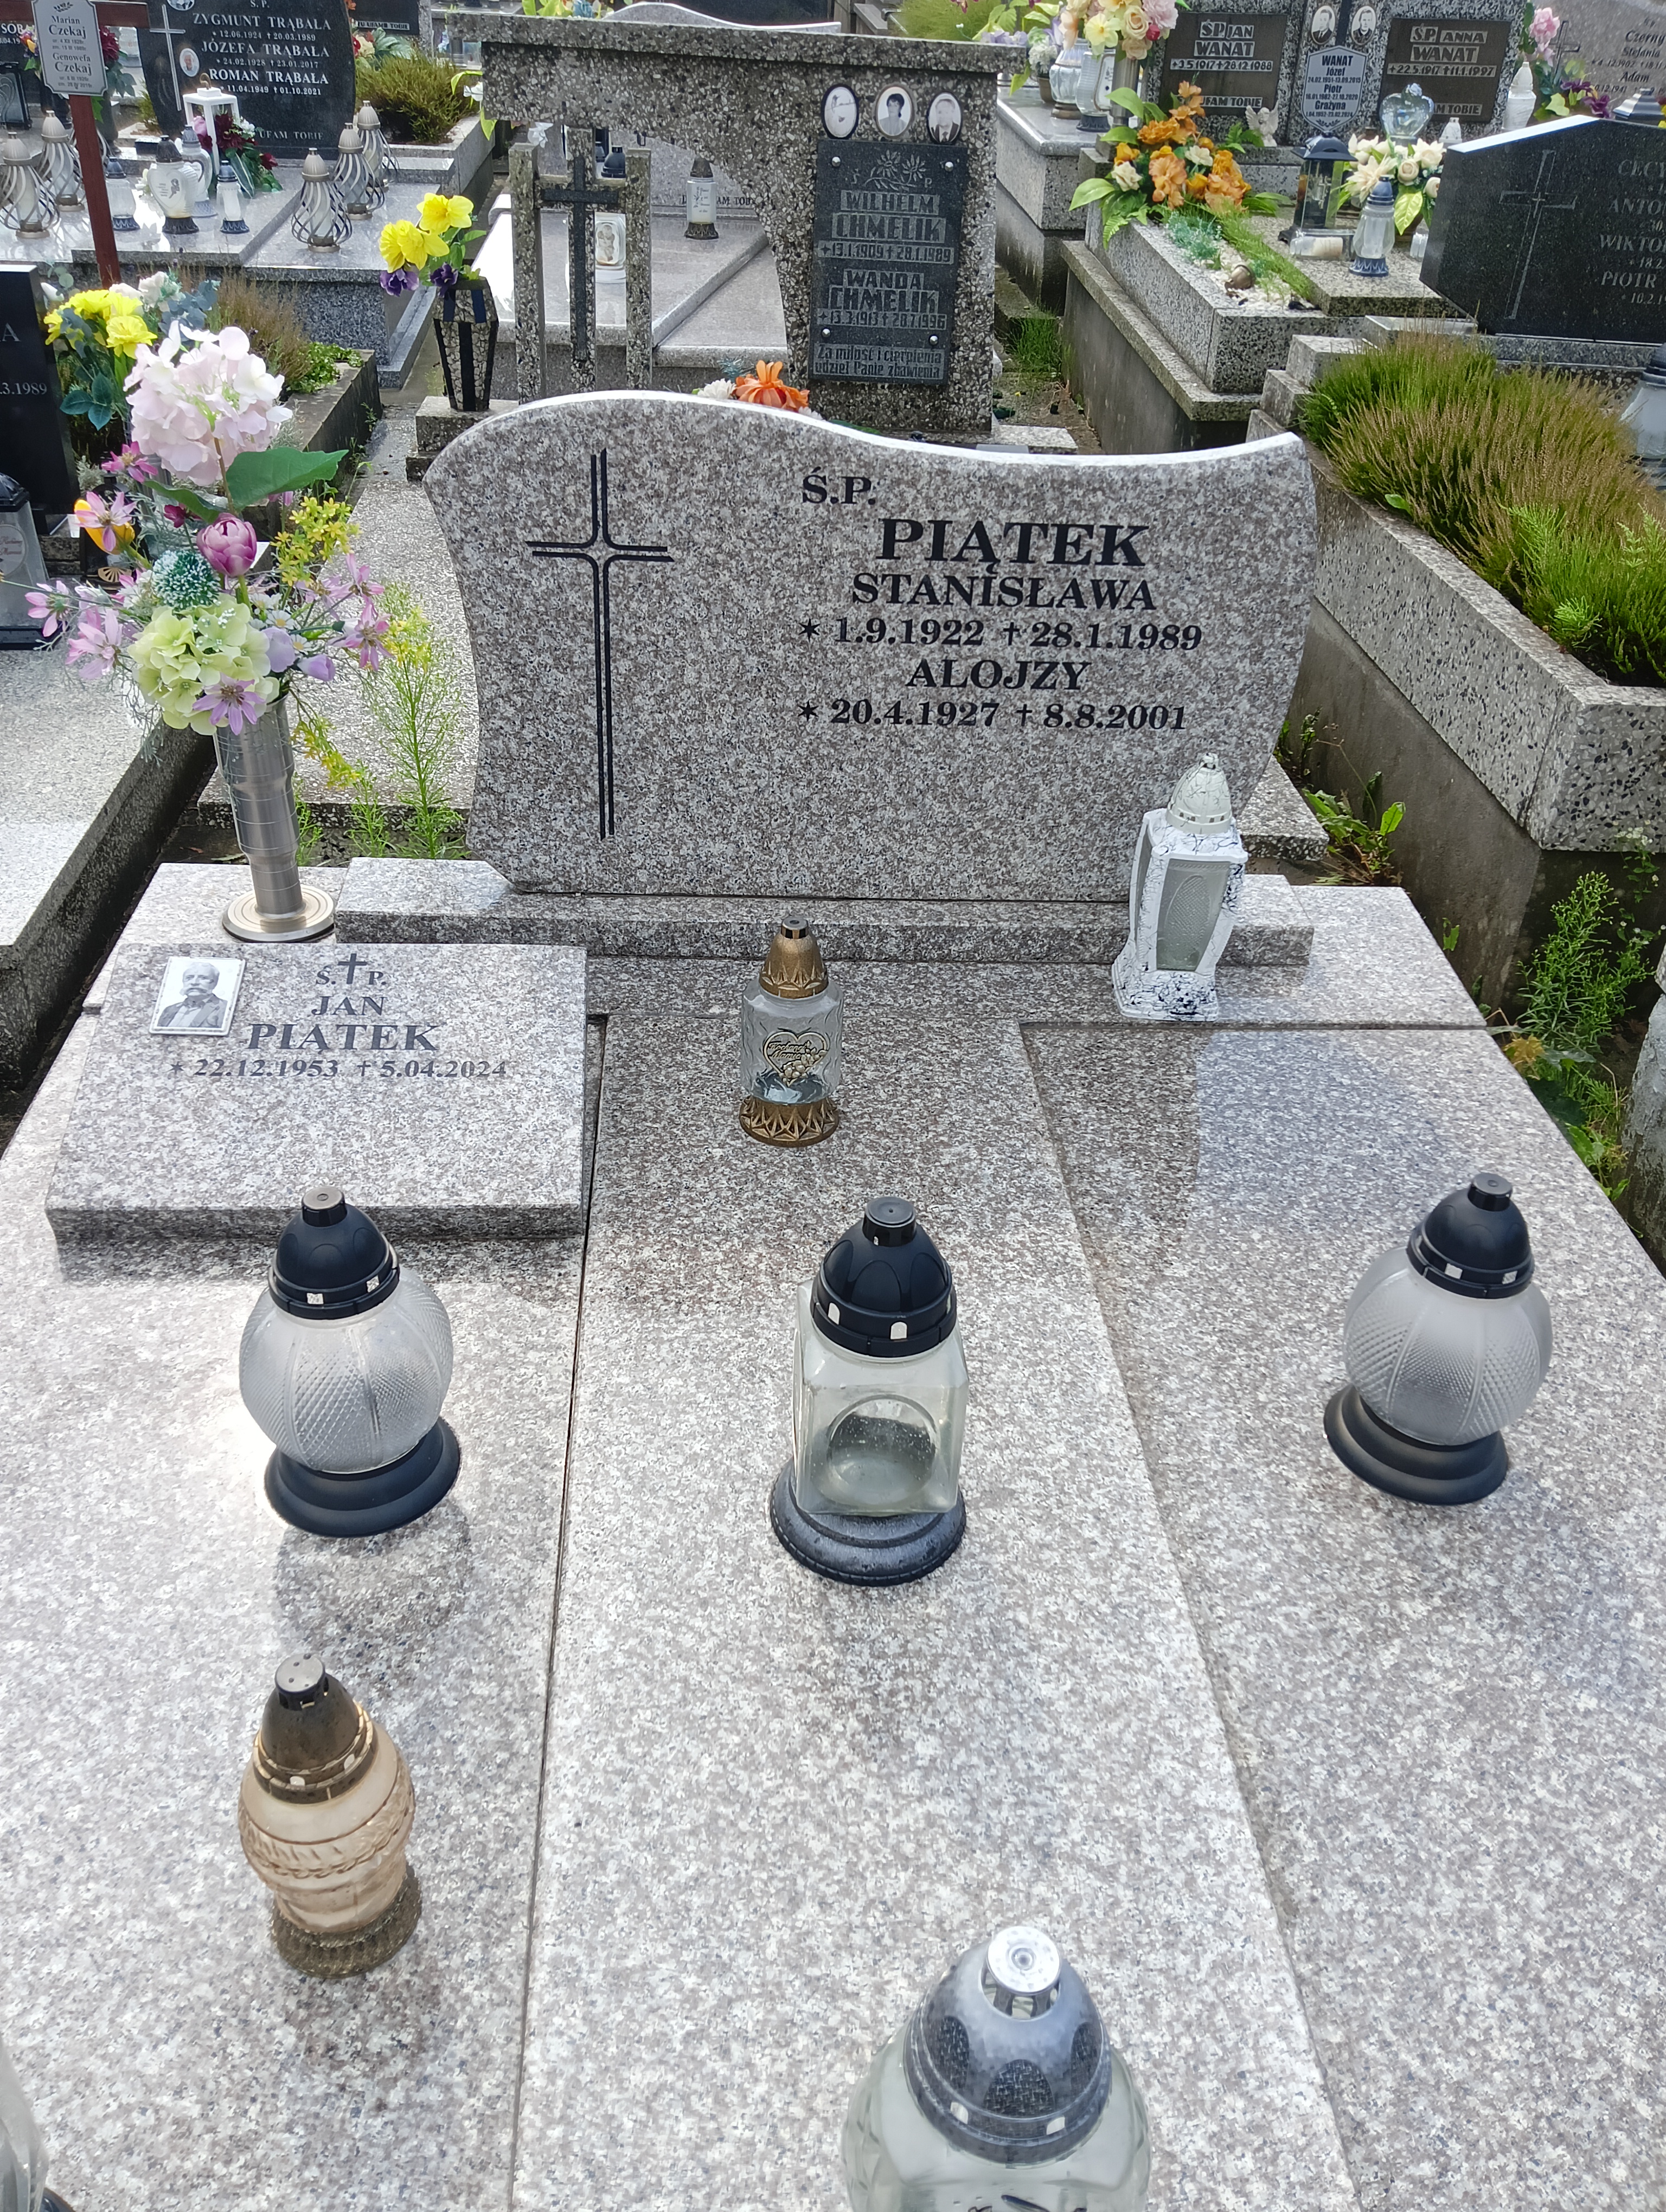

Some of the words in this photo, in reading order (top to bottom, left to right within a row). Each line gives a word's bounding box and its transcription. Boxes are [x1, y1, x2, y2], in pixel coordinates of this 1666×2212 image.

[51, 16, 80, 24] Marian
[193, 13, 260, 27] ZYGMUNT
[267, 16, 331, 32] TRĄBAŁA
[48, 24, 86, 40] Czekaj
[220, 30, 262, 39] 12.06.1924
[273, 33, 316, 41] 20.03.1989
[1226, 25, 1254, 40] JAN
[1442, 31, 1485, 42] ANNA
[1625, 29, 1666, 47] Czerny
[201, 38, 255, 54] JÓZEFA
[262, 43, 330, 59] TRĄBAŁA
[1196, 41, 1255, 56] WANAT
[1413, 46, 1478, 62] WANAT
[53, 52, 91, 62] Genowefa
[223, 57, 266, 66] 24.02.1928
[277, 60, 319, 68] 23.01.2017
[1322, 55, 1354, 66] WANAT
[55, 61, 92, 76] Czekaj
[1325, 66, 1346, 76] Józef
[209, 68, 259, 81] ROMAN
[266, 71, 329, 86] TRĄBAŁA
[1620, 70, 1650, 83] Adam
[227, 85, 269, 93] 11.04.1949
[279, 87, 322, 95] 01.10.2021
[1323, 84, 1343, 93] Piotr
[1231, 97, 1263, 107] TOBIE
[1315, 100, 1347, 111] Grażyna
[1448, 105, 1481, 114] TOBIE
[259, 130, 288, 139] UFAM
[846, 190, 934, 215] WILHELM
[846, 271, 922, 290] WANDA
[1601, 271, 1657, 288] PIOTR
[817, 344, 832, 360] Za
[854, 361, 884, 376] Panie
[802, 466, 876, 505] Ś.P.
[875, 518, 1150, 575] PIĄTEK
[853, 573, 1157, 610] STANISŁAWA
[834, 618, 984, 647] 1.9.1922
[1029, 622, 1202, 651] 28.1.1989
[905, 659, 1092, 691] ALOJZY
[830, 699, 1001, 727] 20.4.1927
[1043, 703, 1187, 730] 8.8.2001
[368, 970, 387, 985] P.
[311, 996, 387, 1016] JAN
[247, 1024, 443, 1054] PIĄTEK
[193, 1058, 338, 1078] 22.12.1953
[380, 1060, 507, 1078] 5.04.2024
